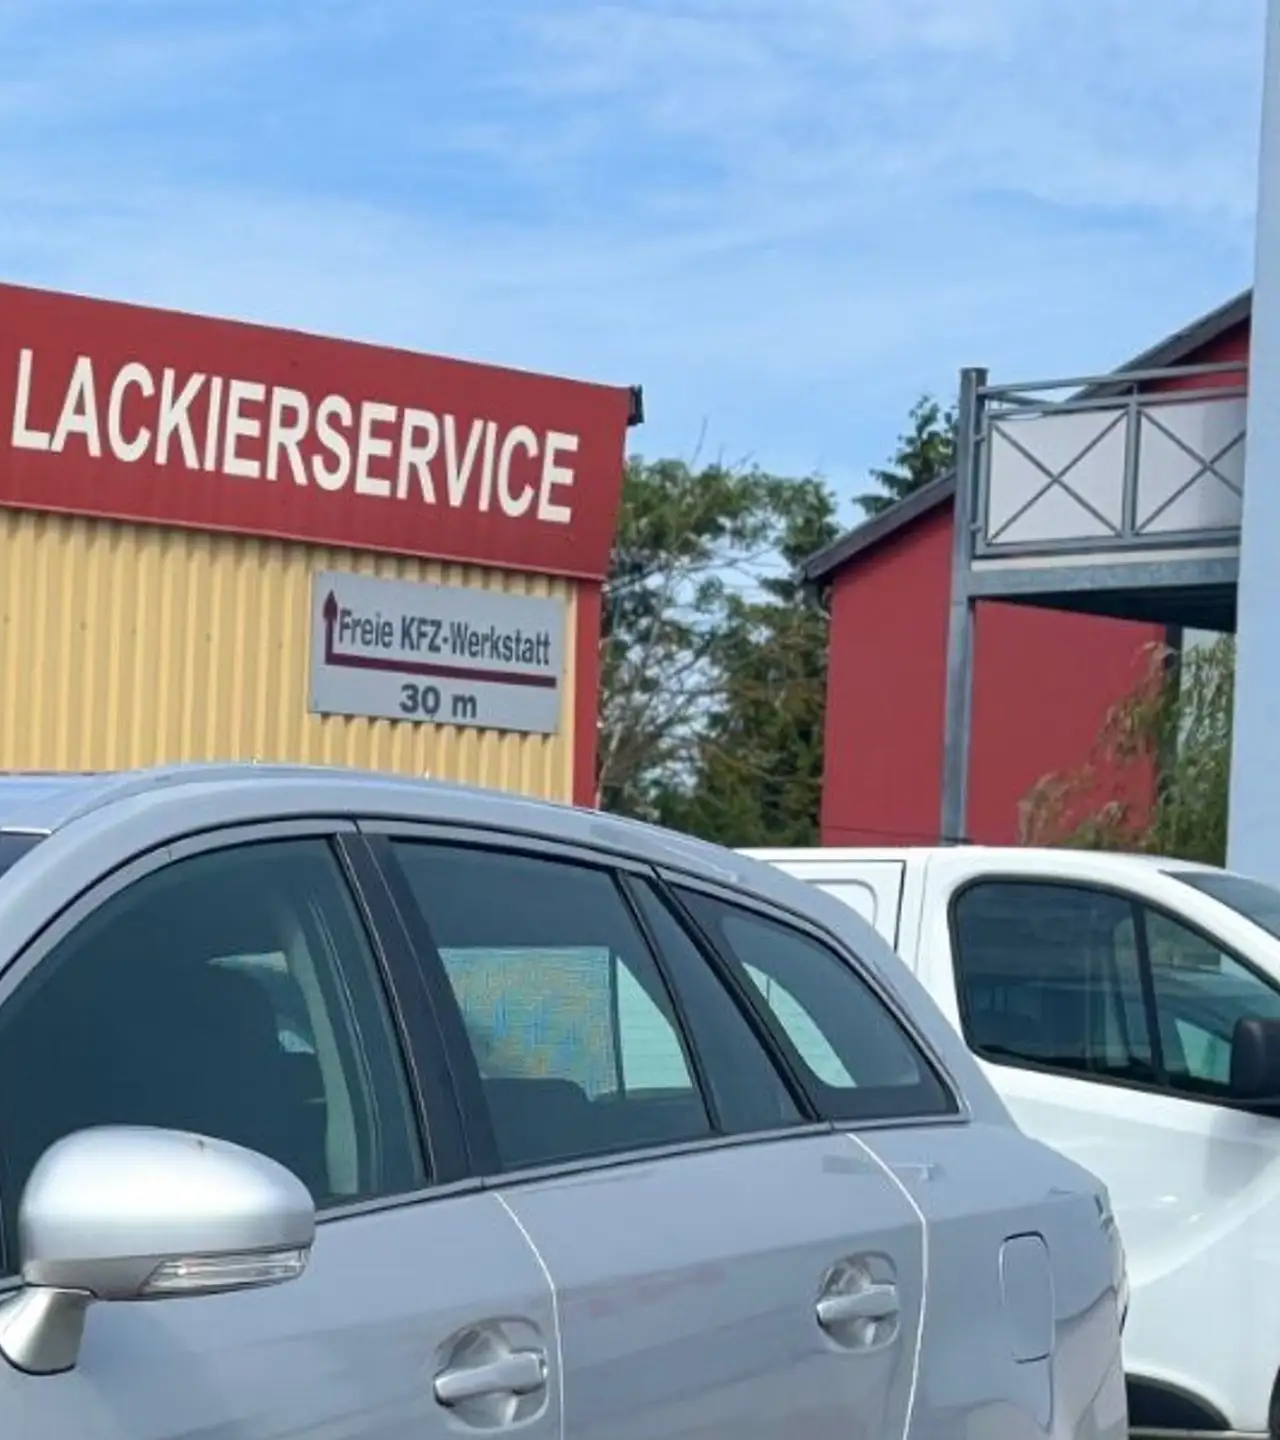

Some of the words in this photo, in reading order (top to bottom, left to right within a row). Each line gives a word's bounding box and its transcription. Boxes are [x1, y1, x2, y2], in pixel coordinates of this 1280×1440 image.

[10, 347, 581, 525] LACKIERSERVICE
[339, 608, 394, 649] Freie
[400, 614, 551, 666] KFZ-Werkstatt
[398, 682, 441, 717] 30
[451, 693, 478, 719] m
